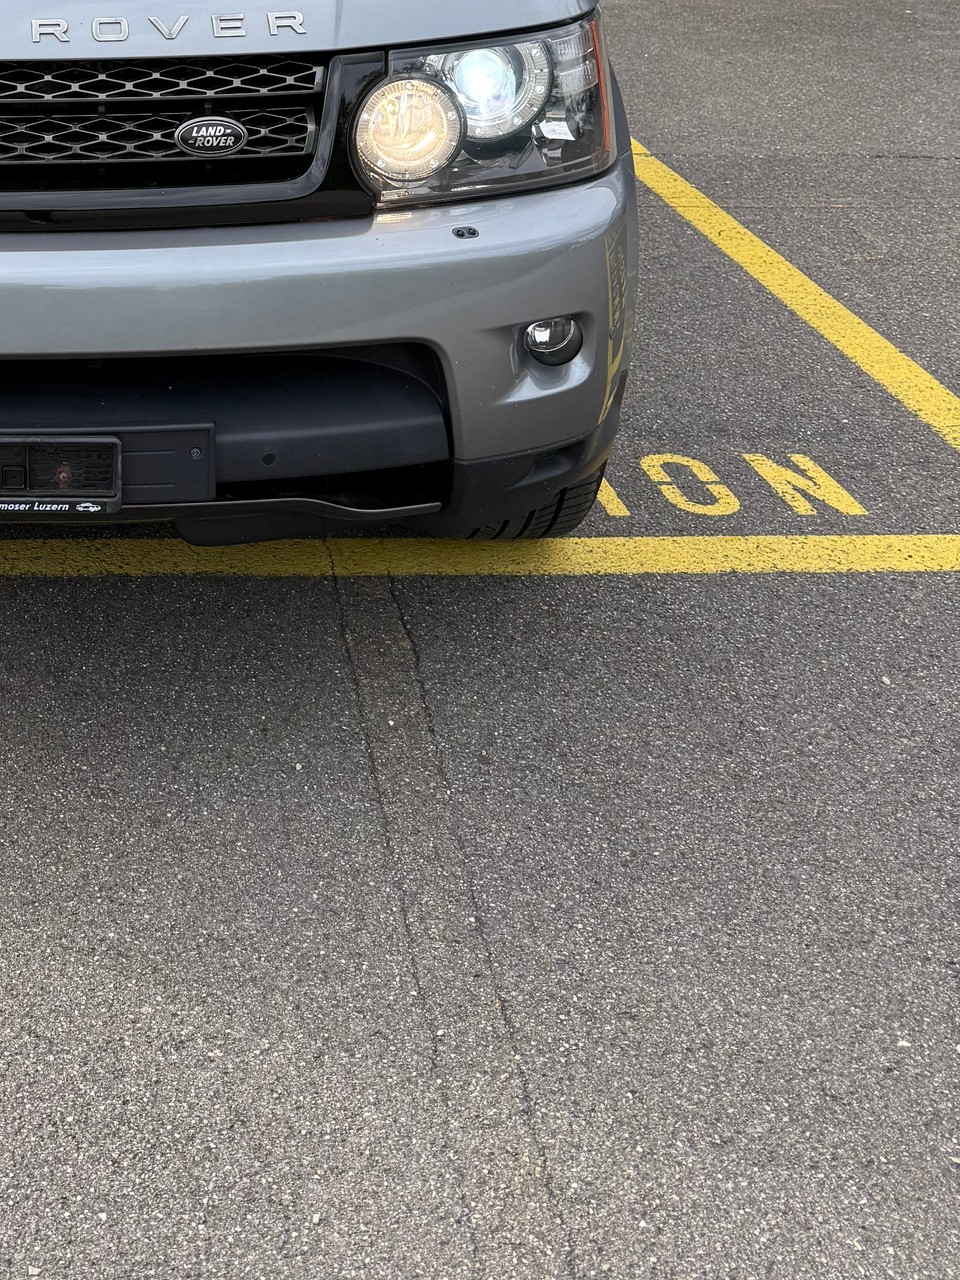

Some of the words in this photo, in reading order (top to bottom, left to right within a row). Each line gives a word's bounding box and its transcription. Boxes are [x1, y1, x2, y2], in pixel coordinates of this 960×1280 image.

[30, 10, 308, 43] ROVER
[192, 126, 225, 136] LAND
[195, 136, 234, 147] ROVER
[33, 502, 70, 511] Luzern
